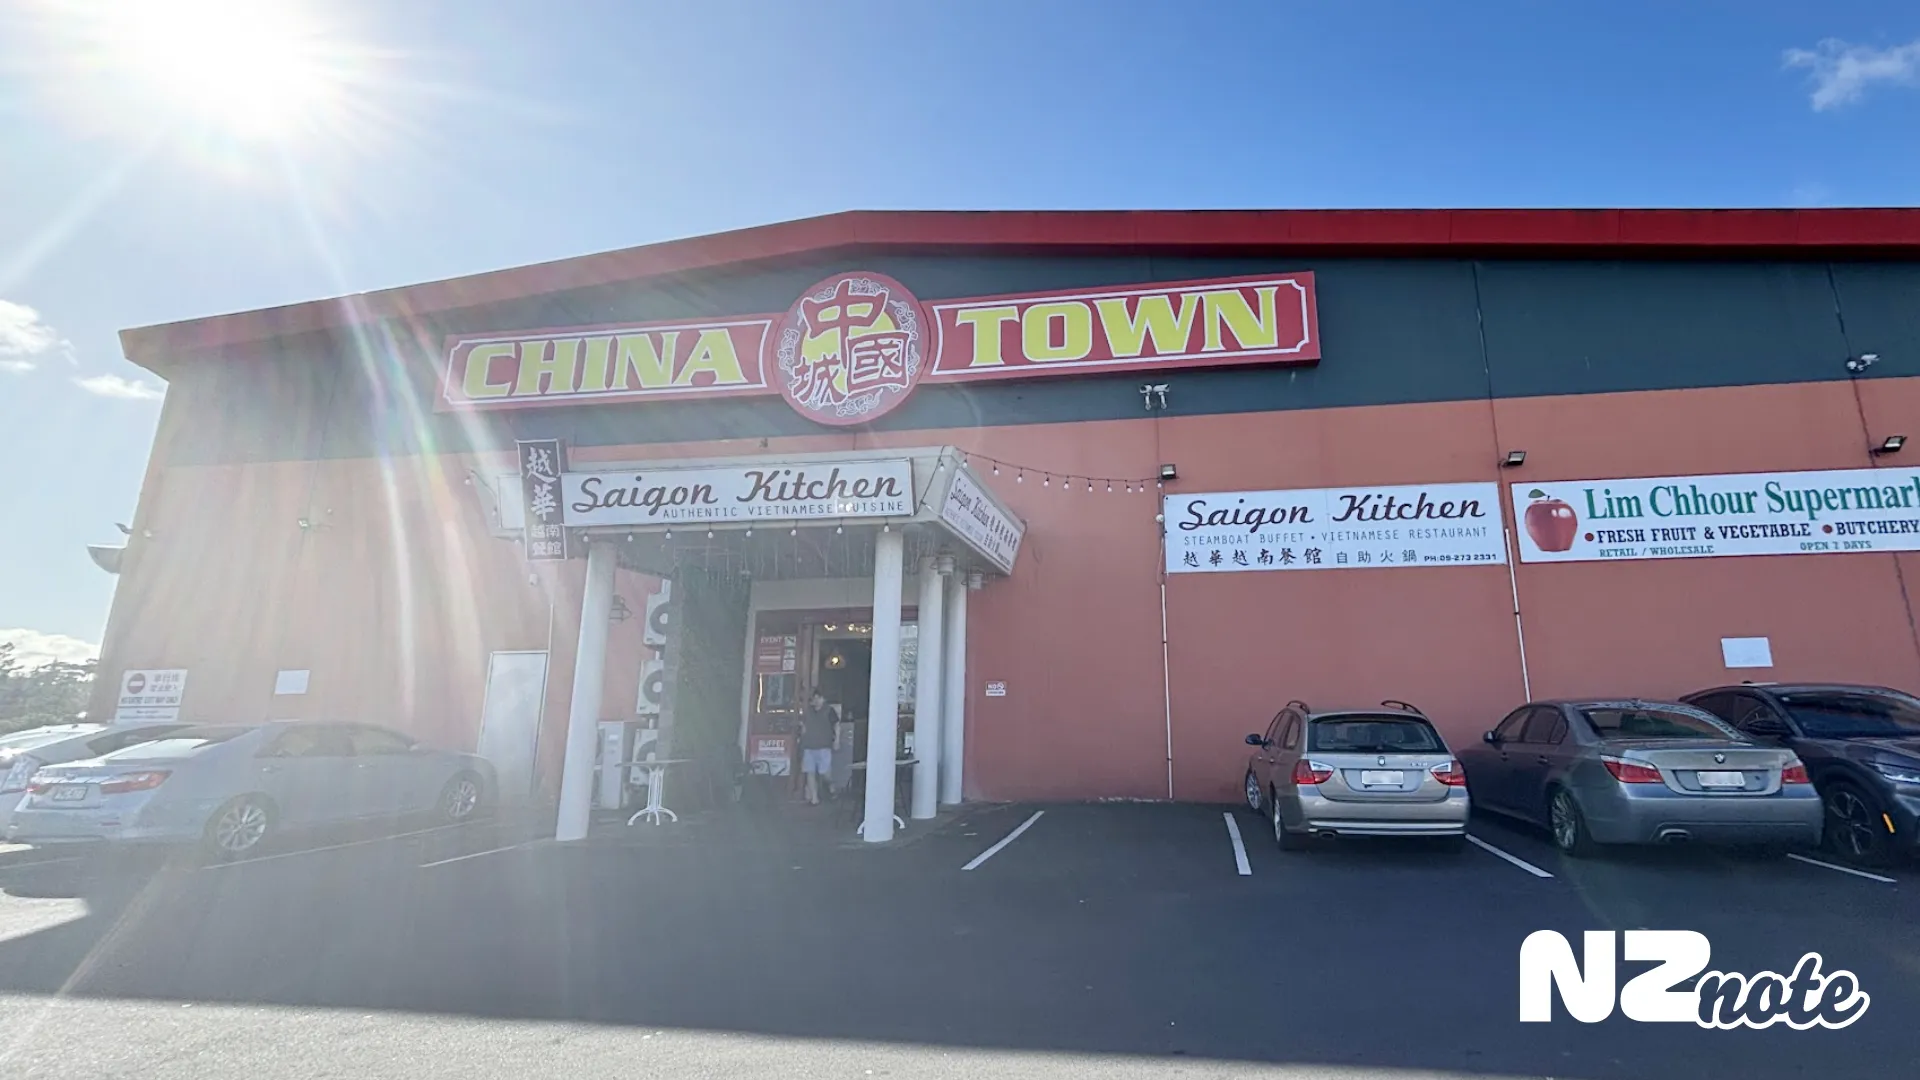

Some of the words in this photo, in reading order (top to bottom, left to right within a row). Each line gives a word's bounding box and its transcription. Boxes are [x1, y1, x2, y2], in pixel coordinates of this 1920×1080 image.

[462, 328, 749, 398] CHINA
[955, 286, 1279, 367] TOWN
[572, 477, 717, 516] Saigon
[736, 468, 902, 502] Kitchen
[1583, 488, 1642, 520] Lim
[1649, 485, 1756, 517] Chhour
[663, 506, 738, 518] AUTHENTIC
[748, 504, 833, 516] VIETNAMESE
[840, 501, 904, 513] UISINE
[1178, 499, 1314, 533] Saigon
[1332, 492, 1485, 522] Kitchen
[1184, 534, 1249, 545] STEAMBOAT
[1260, 532, 1304, 543] BUFFET
[1321, 529, 1399, 542] VIETNAMESE
[1409, 526, 1487, 539] RESTAURANT
[1597, 530, 1646, 543] FRESH
[1652, 528, 1697, 542] FRUIT
[1704, 528, 1715, 541] &
[1719, 523, 1812, 539] VEGETABLE
[1836, 520, 1919, 536] BUTCHERY
[1336, 550, 1418, 565] 自助火鍋
[1599, 547, 1638, 557] RETAIL
[1650, 545, 1715, 555] WHOLESALE
[1800, 542, 1830, 551] OPEN
[1843, 539, 1873, 550] DAYS
